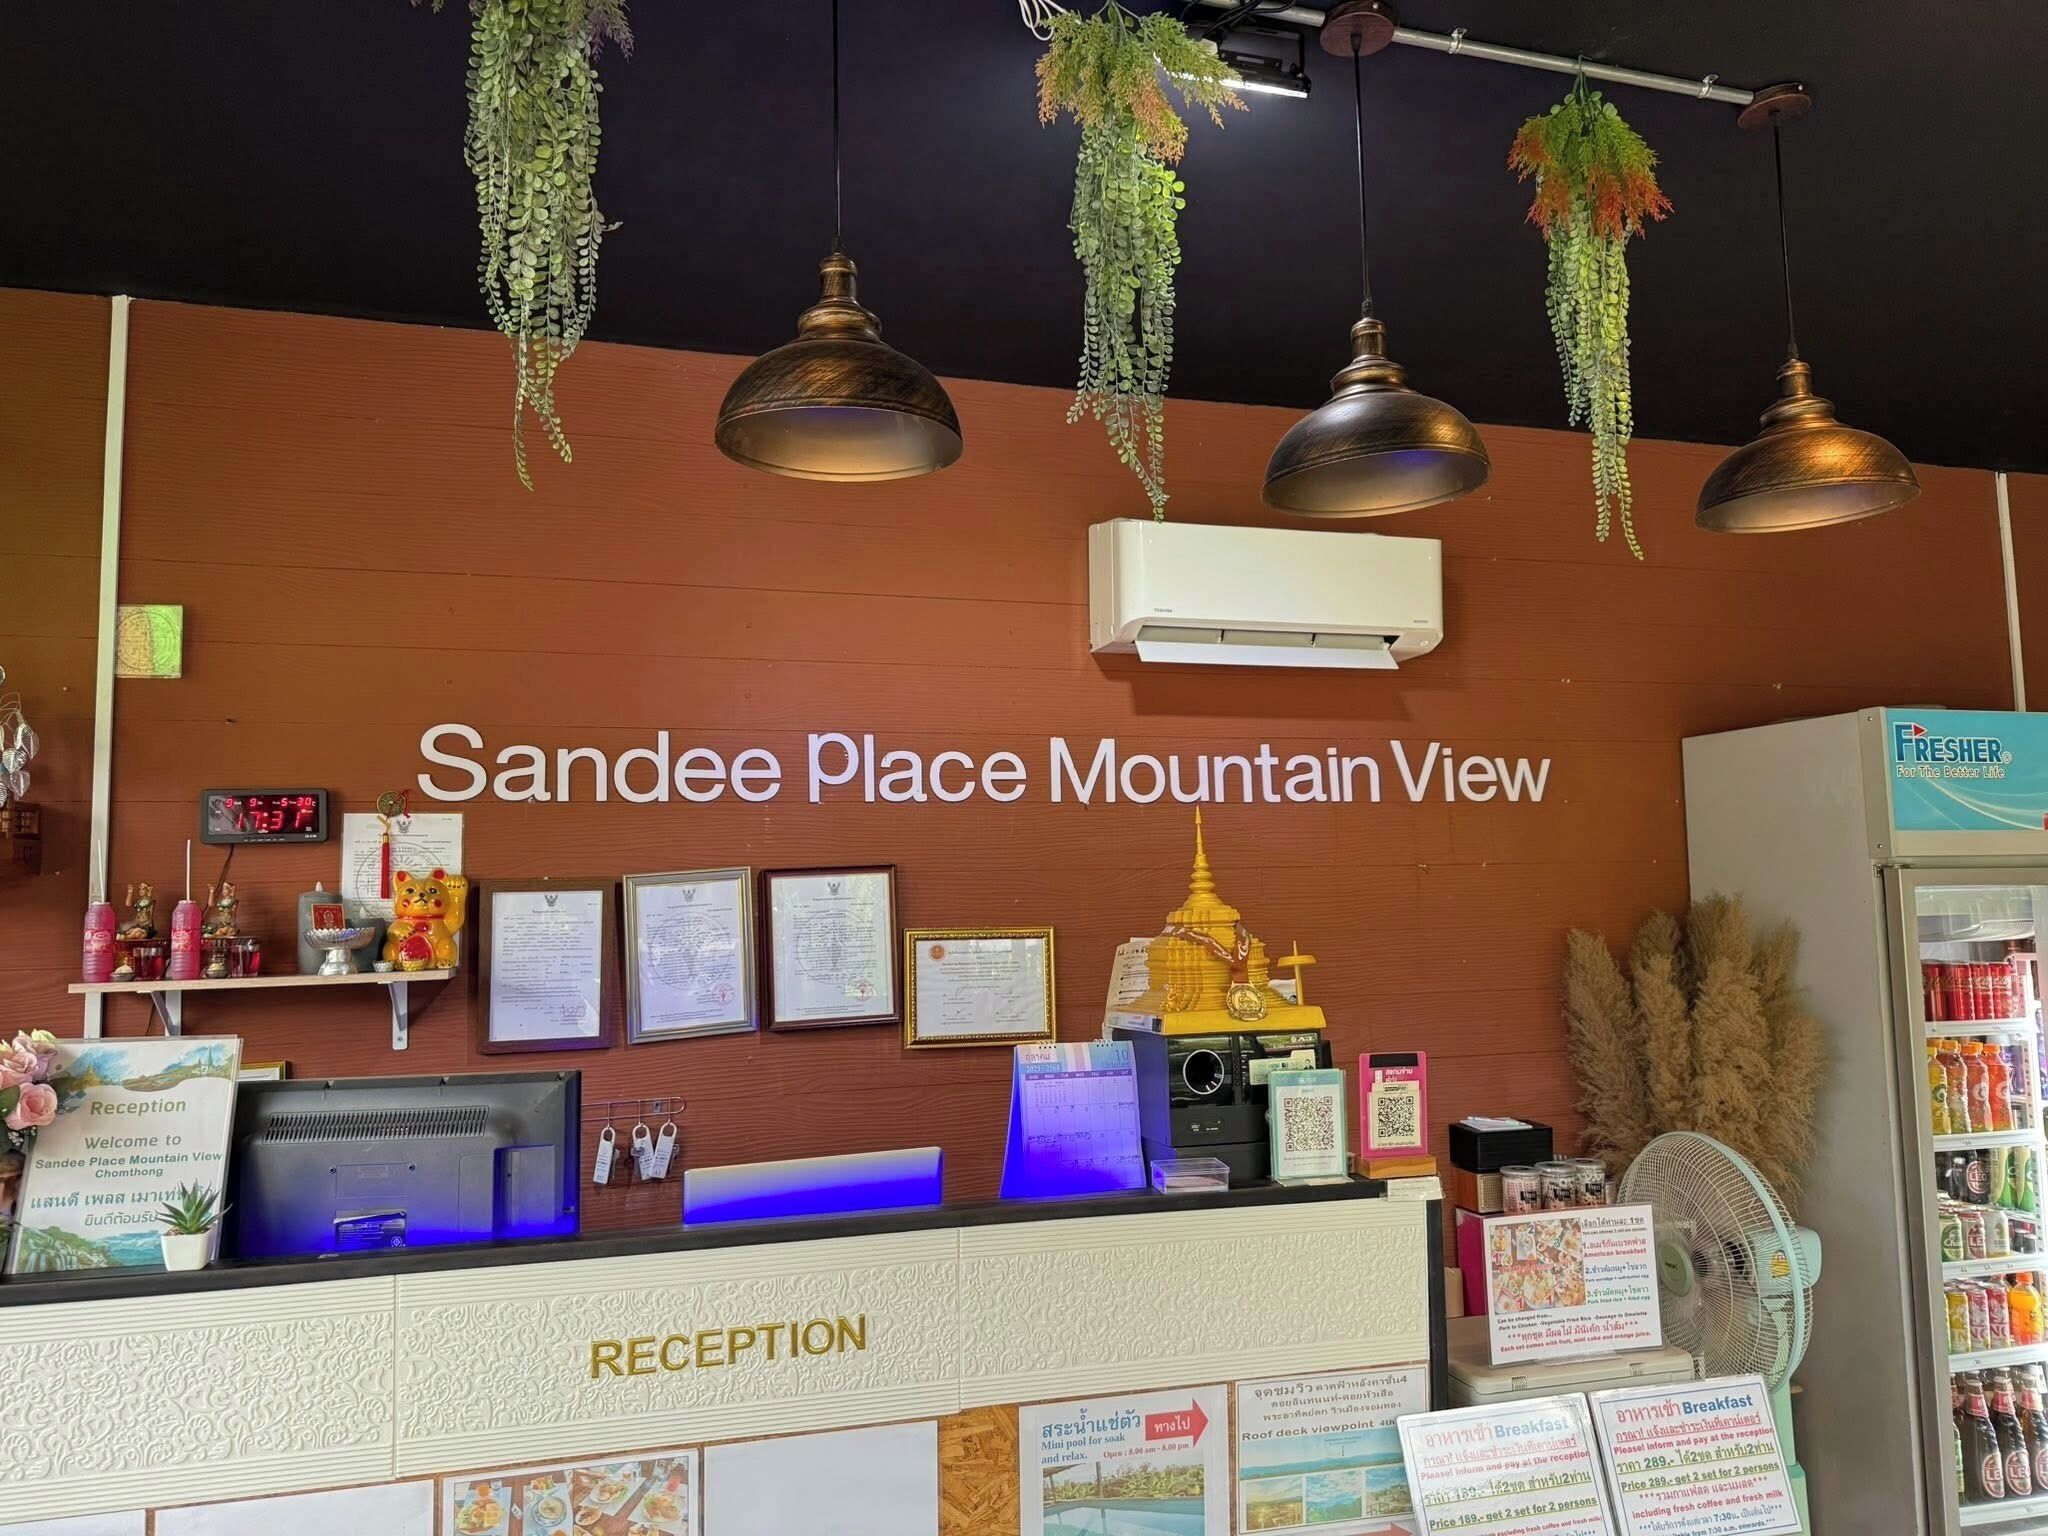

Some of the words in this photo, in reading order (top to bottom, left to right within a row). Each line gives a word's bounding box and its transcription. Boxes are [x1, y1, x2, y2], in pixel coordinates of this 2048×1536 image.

[417, 722, 782, 803] Sandee
[1049, 736, 1381, 804] Mountain
[1390, 740, 1551, 803] View
[1897, 764, 1916, 778] For
[1920, 764, 1941, 778] The
[1944, 764, 1981, 778] Better
[1983, 764, 2006, 779] Life
[90, 1098, 187, 1117] Reception
[84, 1136, 158, 1150] Welcome
[165, 1134, 182, 1146] to
[35, 1156, 86, 1170] Sandee
[89, 1154, 126, 1167] Place
[129, 1152, 189, 1165] Mountain
[192, 1150, 223, 1162] View
[95, 1167, 164, 1180] Chomthong
[31, 1191, 79, 1210] แสนดี
[85, 1192, 125, 1207] เพลส
[84, 1210, 159, 1228] ยินดีต้อนรับ
[1615, 1248, 1647, 1256] breakfast
[590, 1312, 867, 1380] RECEPTION
[1501, 1345, 1515, 1353] Each
[1616, 1398, 1682, 1423] อาหารเช้า
[1683, 1393, 1754, 1415] Breakfast
[1042, 1407, 1141, 1438] สระน้ำแช่ตัว
[1153, 1414, 1192, 1434] ทางไป
[1242, 1430, 1273, 1441] Roof
[1276, 1426, 1308, 1437] deck
[1311, 1419, 1375, 1434] viewpoint
[1494, 1418, 1570, 1438] Breakfast
[1041, 1440, 1064, 1451] Mini
[1066, 1438, 1086, 1451] pool
[1088, 1436, 1103, 1446] for
[1104, 1433, 1125, 1442] soak
[1613, 1444, 1645, 1456] Please!
[1647, 1441, 1674, 1451] inform
[1676, 1438, 1691, 1448] and
[1693, 1437, 1708, 1449] pay
[1711, 1435, 1720, 1443] at
[1721, 1431, 1735, 1441] the
[1736, 1427, 1774, 1441] reception
[1041, 1453, 1060, 1464] and
[1062, 1450, 1088, 1462] relax.
[1103, 1450, 1123, 1460] Open
[1145, 1446, 1157, 1454] am
[1177, 1443, 1189, 1451] pm
[1486, 1462, 1502, 1472] and
[1504, 1460, 1520, 1472] pay
[1522, 1458, 1532, 1467] at
[1533, 1456, 1548, 1465] the
[1550, 1450, 1590, 1465] reception
[1617, 1460, 1642, 1475] ราคา
[1621, 1480, 1647, 1492] Price
[1674, 1474, 1691, 1486] get
[1692, 1471, 1700, 1481] 2
[1702, 1469, 1716, 1480] set
[1718, 1467, 1732, 1478] for
[1734, 1465, 1741, 1476] 2
[1743, 1462, 1780, 1475] persons
[1429, 1518, 1457, 1530] Price
[1486, 1511, 1503, 1523] get
[1504, 1508, 1512, 1518] 2
[1514, 1506, 1530, 1517] set
[1532, 1503, 1547, 1514] for
[1549, 1501, 1556, 1511] 2
[1558, 1496, 1597, 1511] persons
[1632, 1505, 1672, 1520] including
[1672, 1502, 1696, 1514] fresh
[1697, 1498, 1723, 1510] coffee
[1724, 1496, 1741, 1506] and
[1742, 1492, 1764, 1503] fresh
[1765, 1489, 1784, 1500] milk
[1526, 1525, 1541, 1533] fresh
[1542, 1522, 1560, 1530] coffee
[1572, 1517, 1587, 1525] fresh
